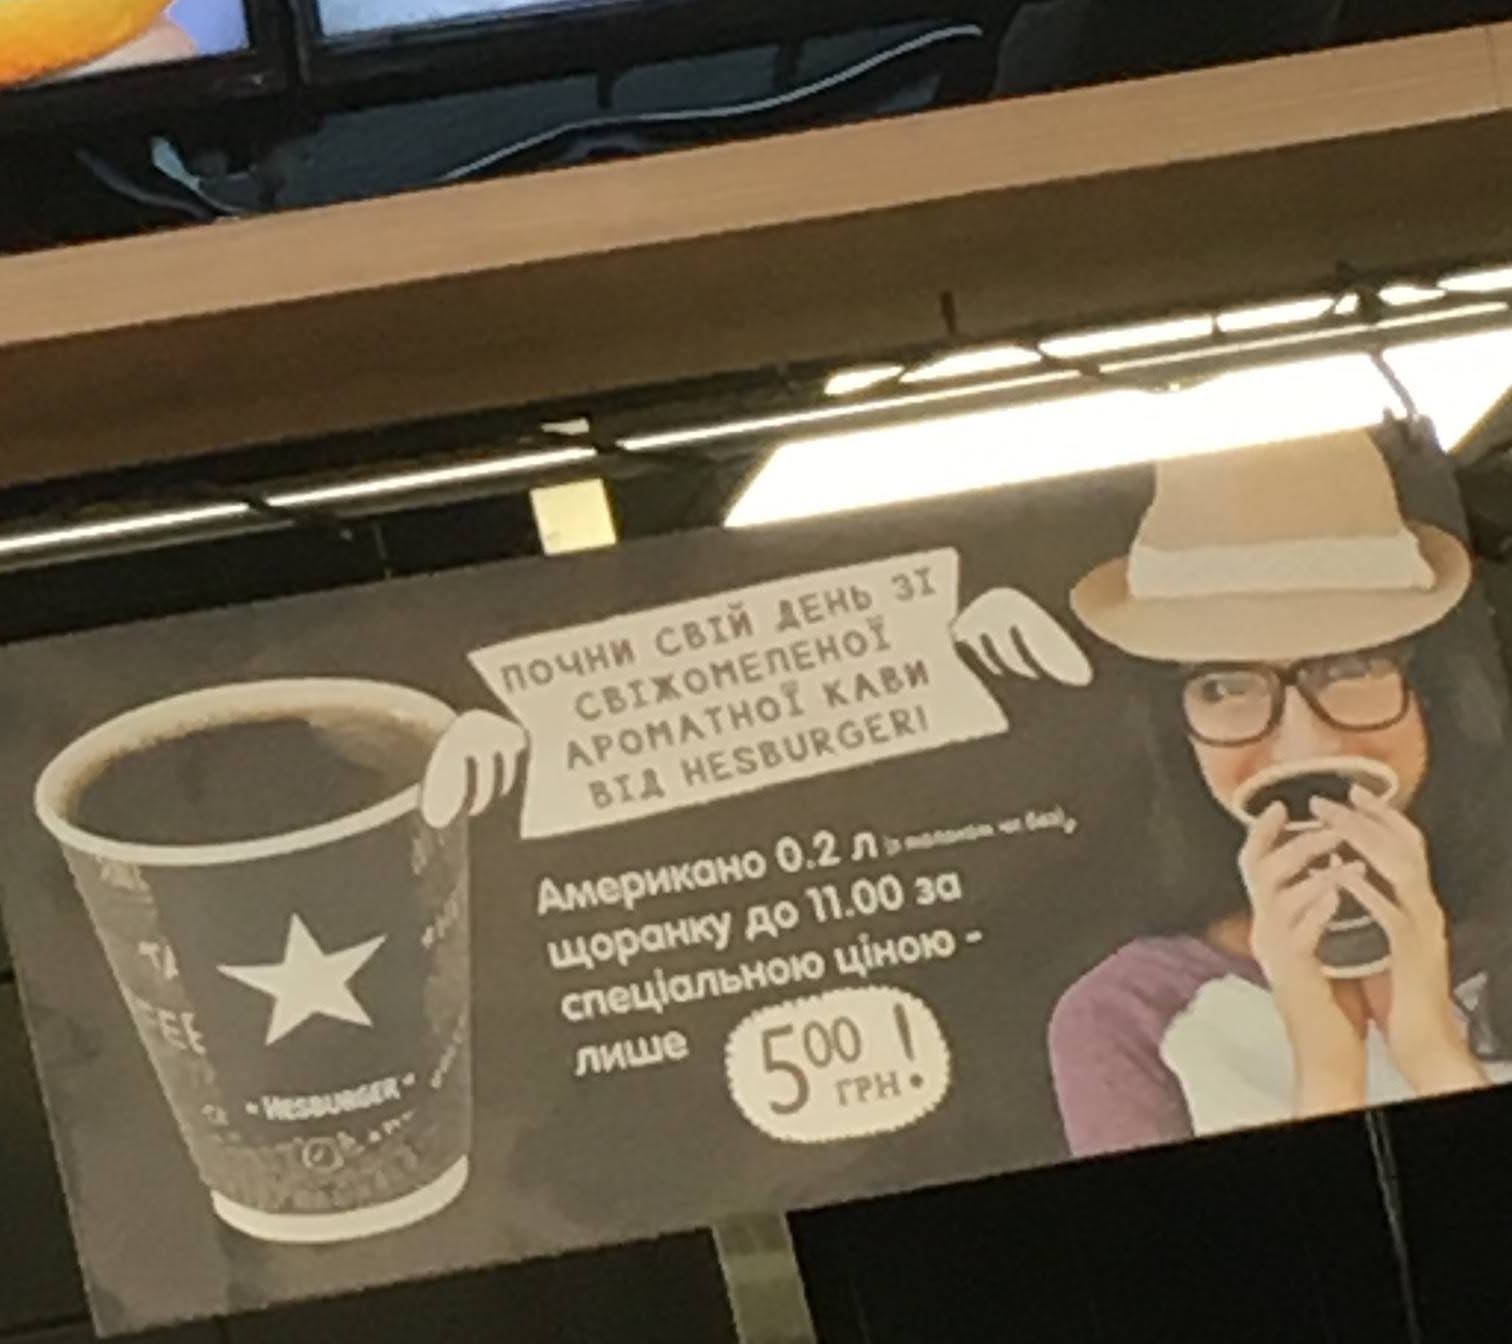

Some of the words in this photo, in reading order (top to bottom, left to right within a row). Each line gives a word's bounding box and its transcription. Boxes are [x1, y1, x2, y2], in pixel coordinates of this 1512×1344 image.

[499, 638, 636, 694] ПОЧНИ
[654, 603, 754, 659] СВІЙ
[774, 584, 875, 633] ДЕНЬ
[891, 567, 936, 601] ЗІ
[572, 617, 892, 723] СВІЖОМЕЛЕНОЇ
[565, 680, 807, 772] АРОМАТНОЇ
[825, 659, 932, 709] КАВИ
[588, 768, 668, 809] ВІД
[536, 848, 768, 916] Американо
[775, 829, 841, 874] 0.2
[851, 831, 879, 861] л
[547, 910, 733, 972] щоранку
[744, 898, 800, 941] до
[806, 875, 905, 923] 11.00
[913, 871, 963, 906] за
[560, 947, 825, 1022] спеціальною
[834, 926, 957, 981] ціною
[574, 1027, 690, 1078] лише
